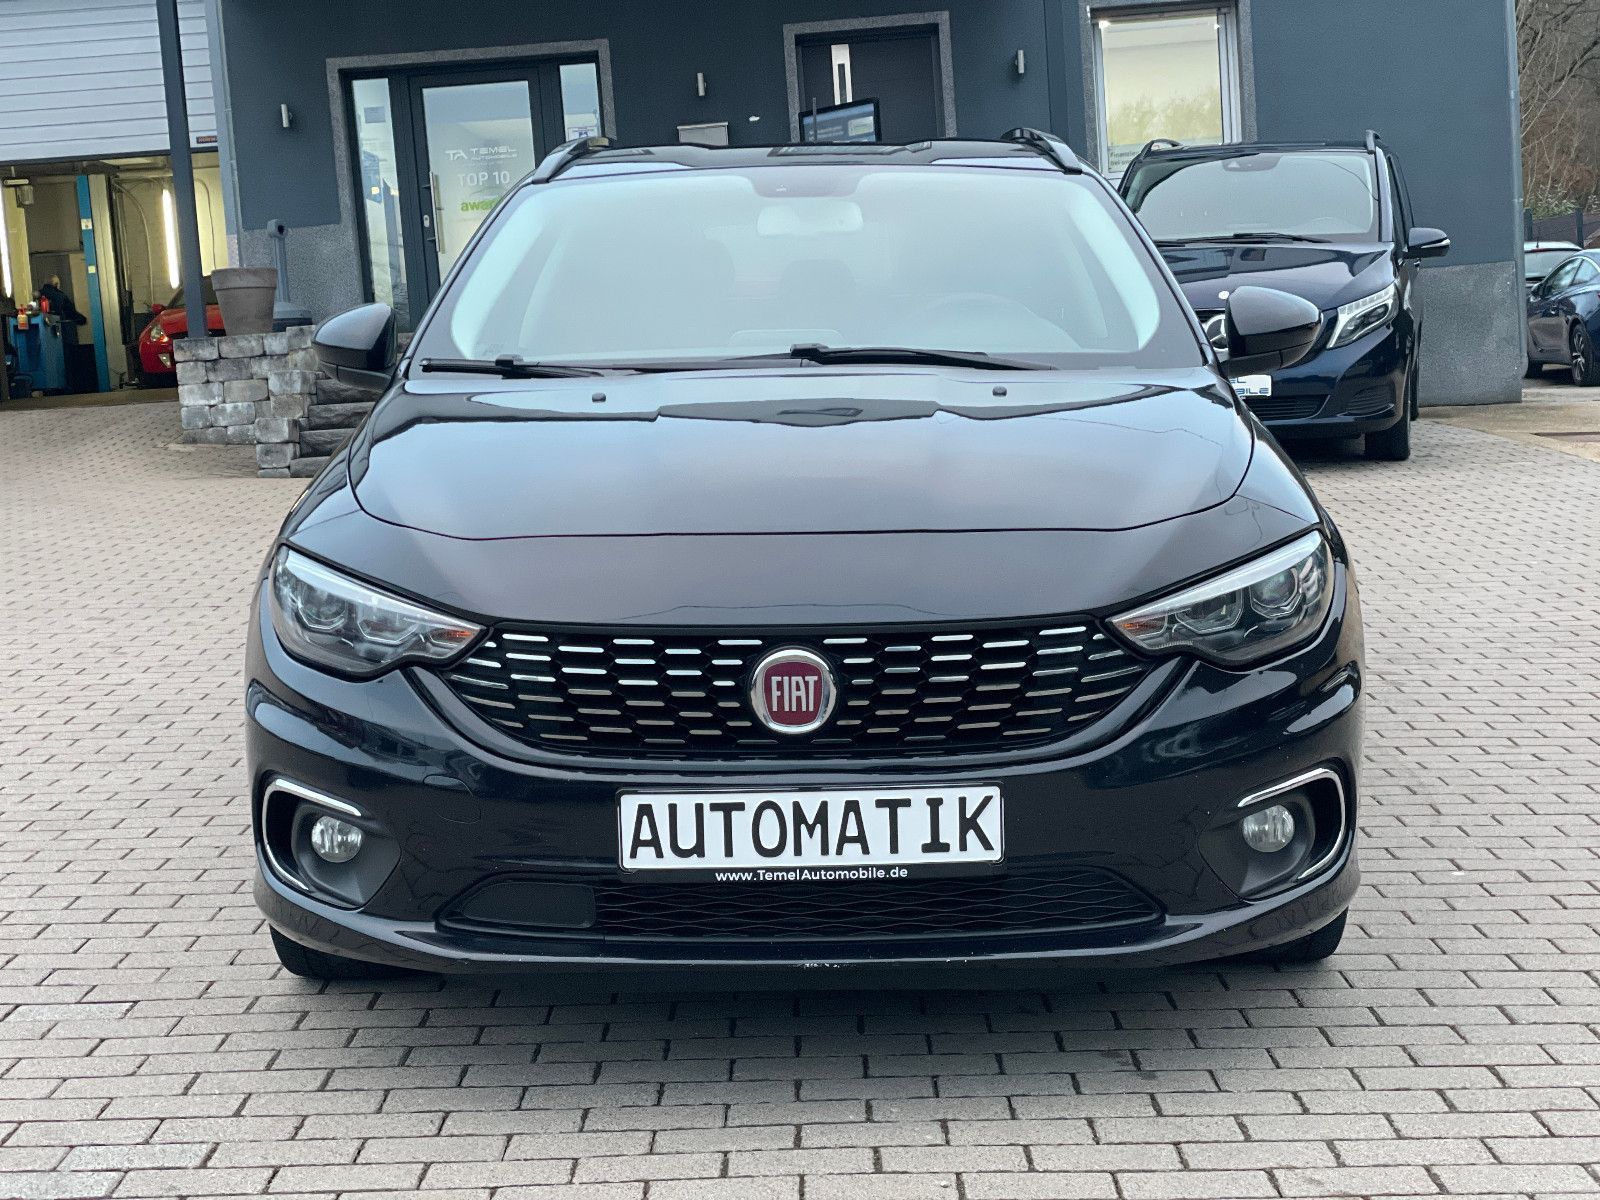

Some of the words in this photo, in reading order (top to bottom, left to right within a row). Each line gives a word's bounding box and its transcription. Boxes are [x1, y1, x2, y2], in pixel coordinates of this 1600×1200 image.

[470, 145, 518, 155] TEMEL
[457, 171, 489, 188] TOP
[492, 170, 510, 185] 10
[771, 676, 819, 712] FIAT
[629, 795, 995, 859] AUTOMATIK
[715, 867, 908, 881] www.TemelAutomobile.de
